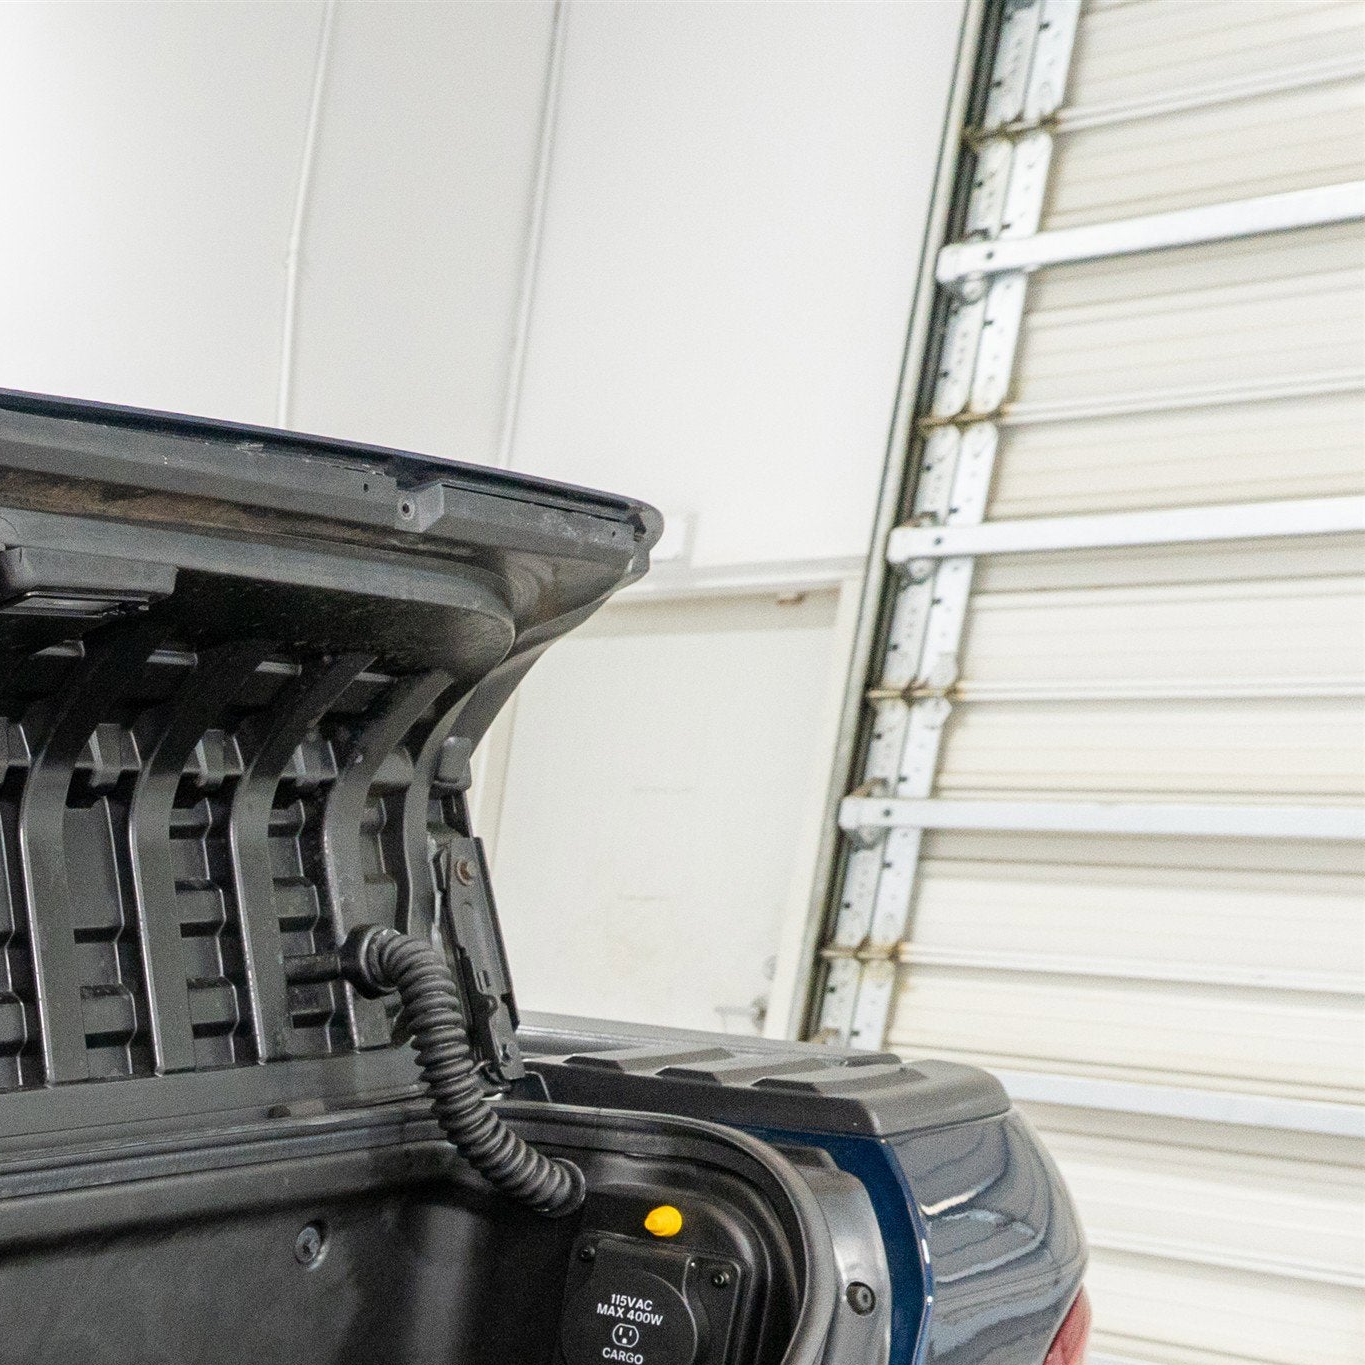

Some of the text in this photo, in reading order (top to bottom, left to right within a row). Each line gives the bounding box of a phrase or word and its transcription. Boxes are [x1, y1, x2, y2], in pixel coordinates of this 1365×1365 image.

[611, 1294, 653, 1311] 115VAC
[596, 1303, 663, 1325] MAX 400W
[602, 1347, 644, 1365] CARGO
